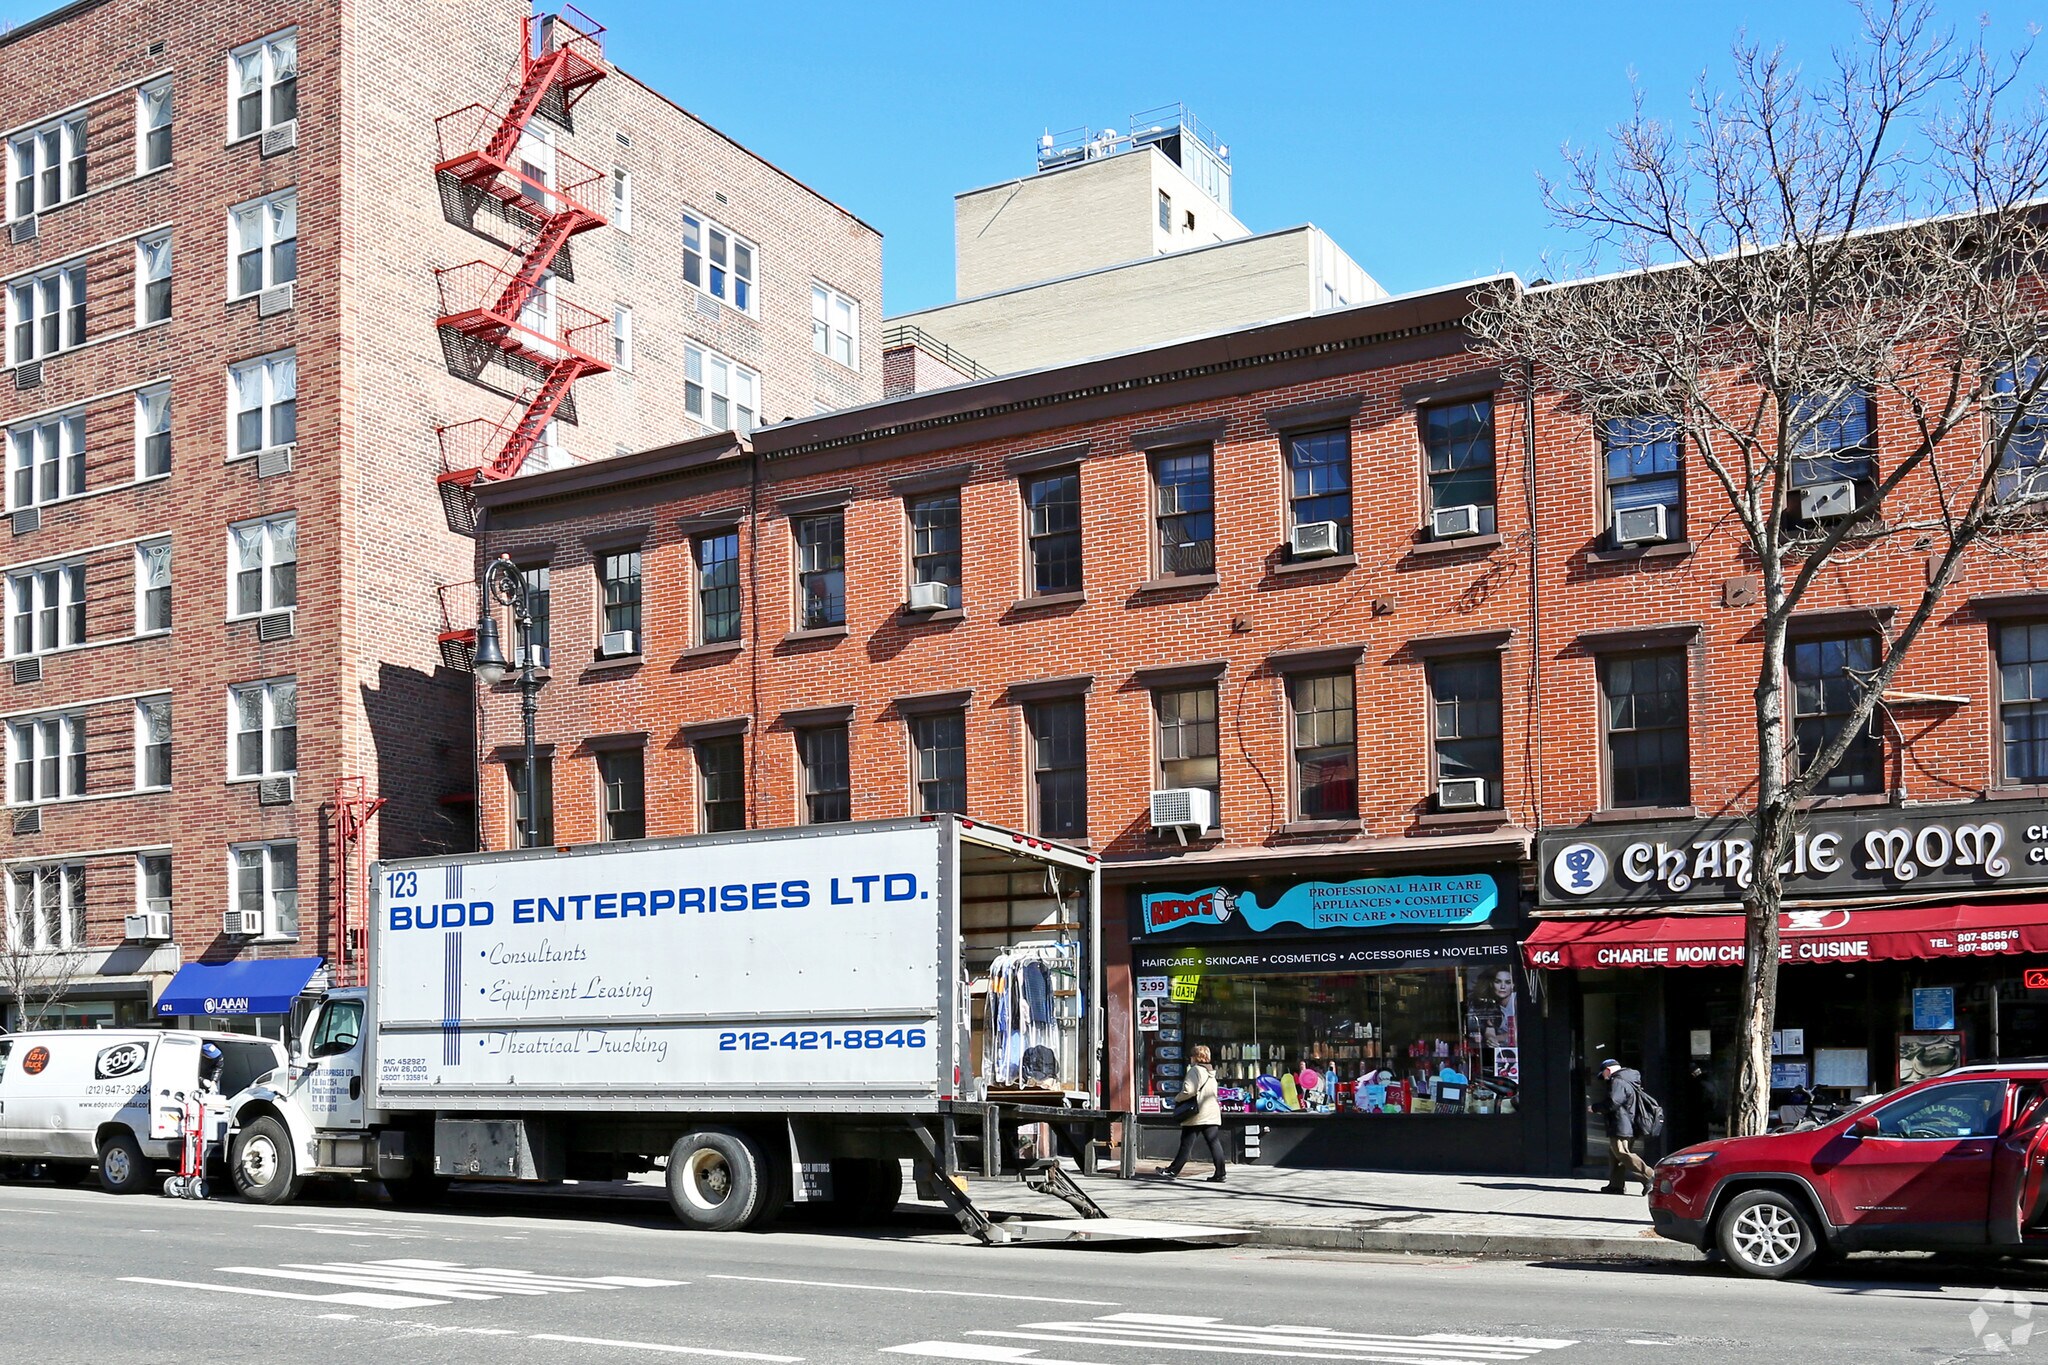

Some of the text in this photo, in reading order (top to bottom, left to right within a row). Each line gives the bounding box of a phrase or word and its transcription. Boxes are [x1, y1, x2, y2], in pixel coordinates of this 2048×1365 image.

[1865, 822, 2012, 881] MOM
[387, 871, 418, 899] 123
[1309, 880, 1482, 897] PROFESSIONAL HAIR CARE
[389, 873, 929, 931] BUDD ENTERPRISES LTD.
[1151, 893, 1214, 926] RICKY'S
[1313, 893, 1479, 910] APPLIANCES COSMETICS
[1318, 907, 1472, 923] SKIN CARE NOVELTIES
[1929, 938, 1952, 948] TEL.
[1957, 930, 2019, 943] 807-8585/6
[1957, 941, 2008, 953] 807-8099
[489, 938, 588, 965] Consultants
[1142, 945, 1508, 967] HAIRCARE SKINCARE COSMETICS ACCESSORIES NOVELTIES
[1532, 951, 1560, 964] 464
[1597, 947, 1668, 963] CHARLIE
[1675, 946, 1717, 962] MOM
[1800, 940, 1869, 959] CUISINE
[489, 975, 653, 1010] Equipment Leasing
[1141, 981, 1165, 991] 3.99
[161, 1004, 173, 1012] 474
[488, 1027, 668, 1063] Theatrical Trucking
[719, 1028, 926, 1051] 212-421-8846
